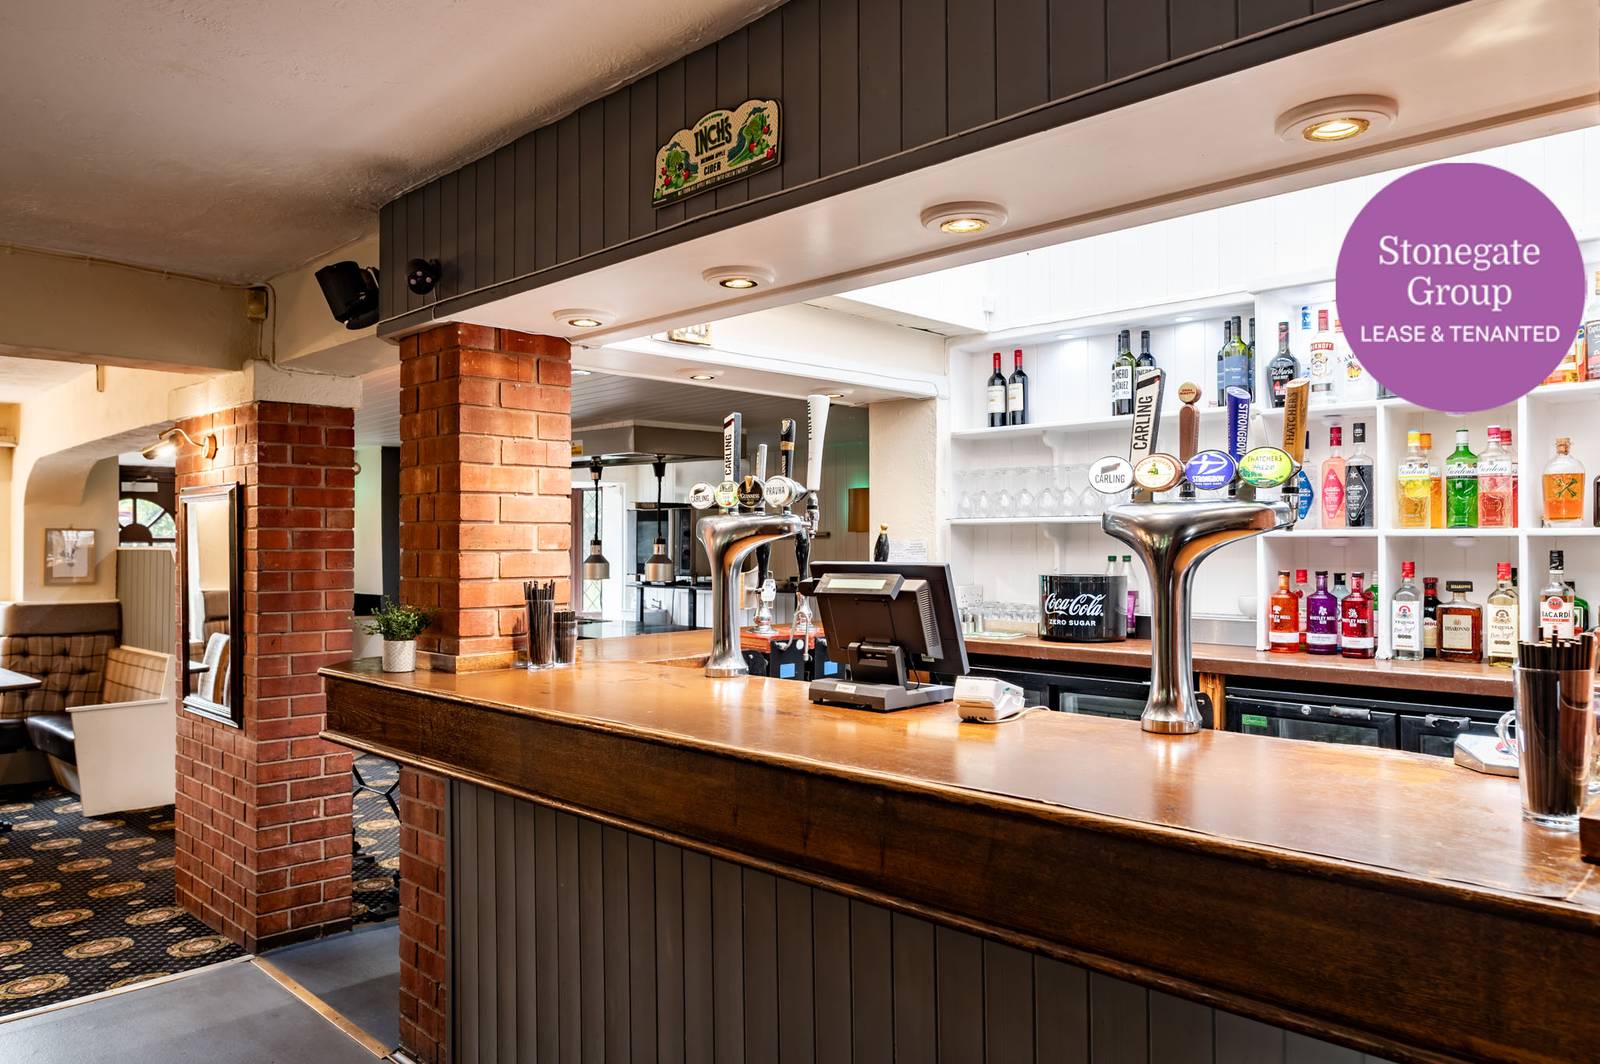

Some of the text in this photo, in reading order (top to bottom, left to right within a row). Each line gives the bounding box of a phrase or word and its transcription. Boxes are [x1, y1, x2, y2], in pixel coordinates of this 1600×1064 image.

[703, 162, 721, 176] CIDER
[1133, 395, 1153, 450] CARLING
[1285, 391, 1298, 446] THATCHERS
[1236, 403, 1248, 455] STRONGBOW
[724, 433, 732, 476] CARLING
[1247, 454, 1283, 463] THATCHERS
[1094, 474, 1126, 484] CARLING
[690, 494, 710, 502] CARLING
[1045, 592, 1107, 617] Coca-Cola
[1068, 619, 1096, 627] SUGAR
